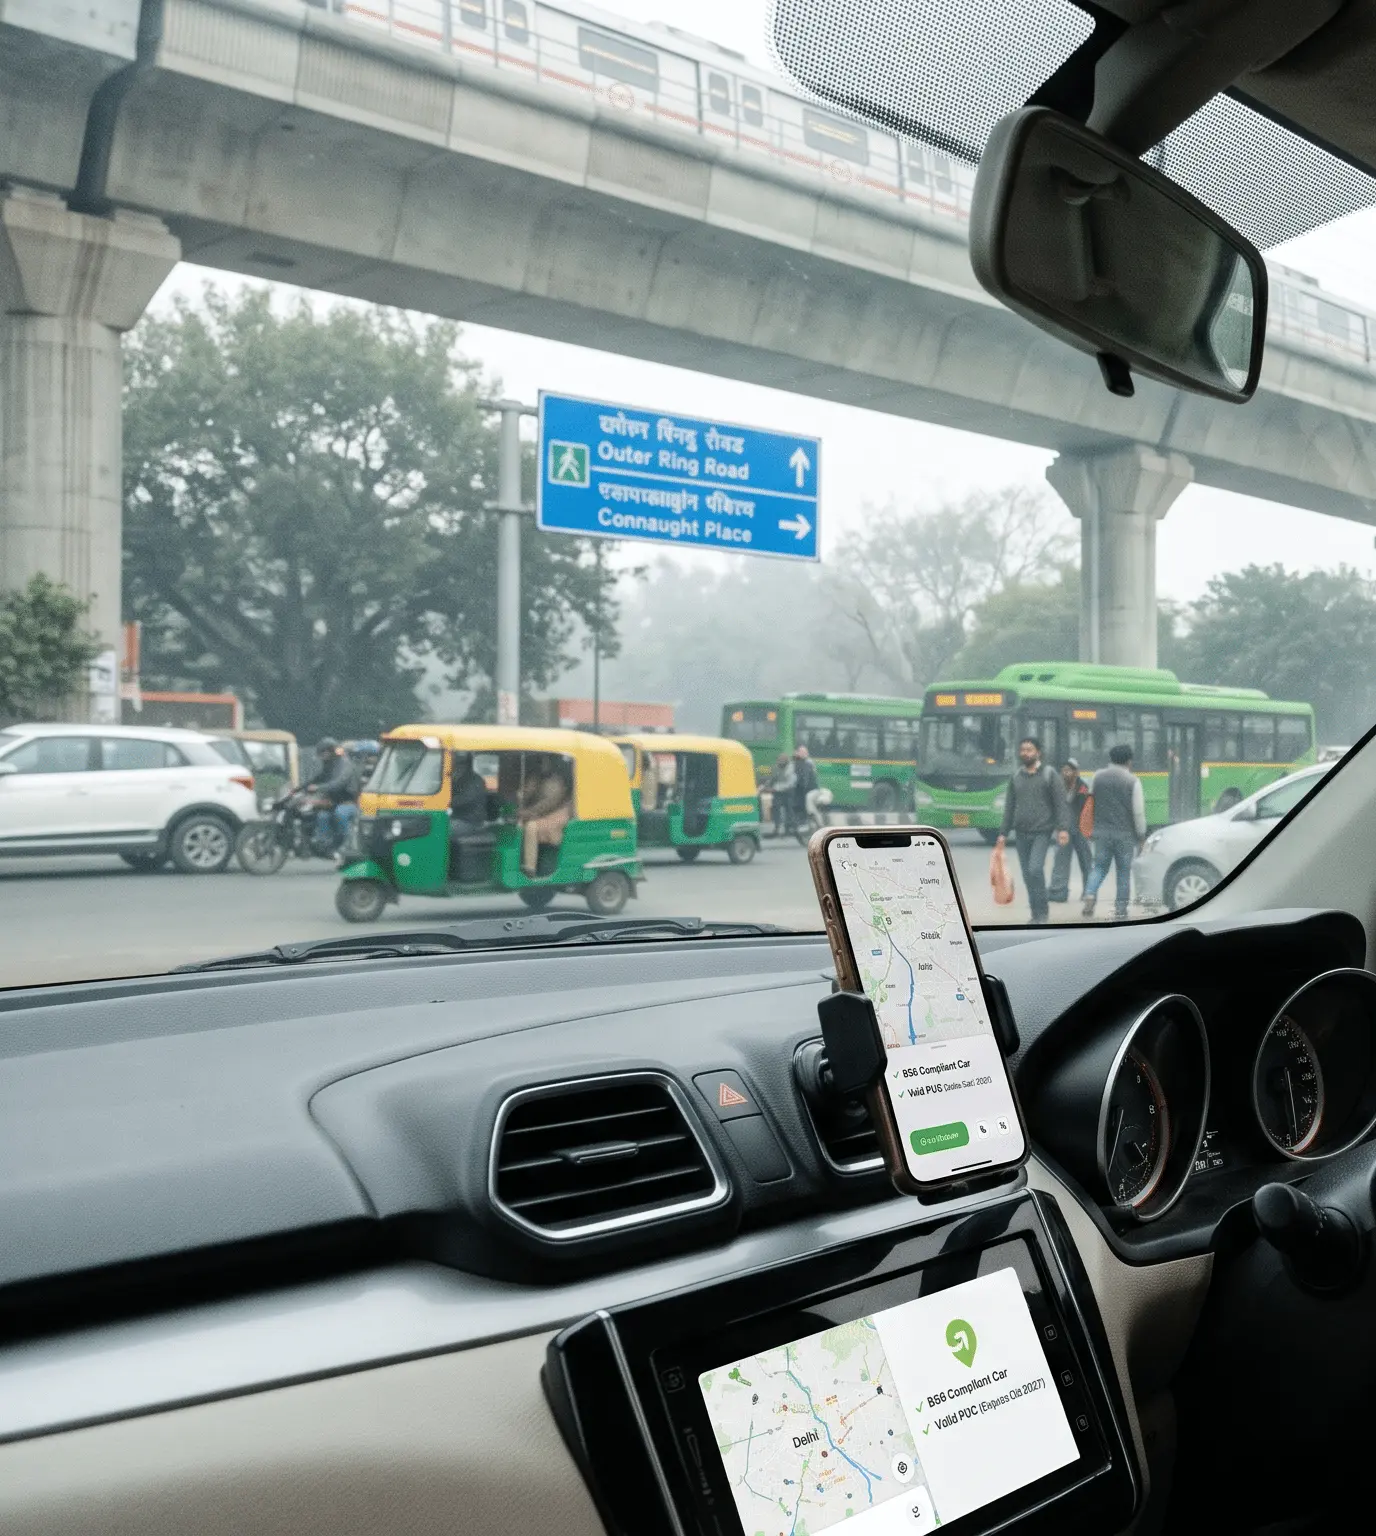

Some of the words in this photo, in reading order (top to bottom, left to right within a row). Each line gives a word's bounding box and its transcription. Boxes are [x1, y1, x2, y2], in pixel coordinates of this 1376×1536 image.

[598, 440, 652, 466] Outer
[658, 450, 699, 477] Ring
[704, 456, 750, 481] Road
[597, 506, 700, 538] Connaught
[704, 519, 753, 543] Place
[902, 1067, 918, 1079] BS6
[957, 1059, 971, 1069] Car
[991, 1369, 1008, 1382] Car
[958, 1405, 979, 1422] PUC
[792, 1431, 820, 1449] Delhi
